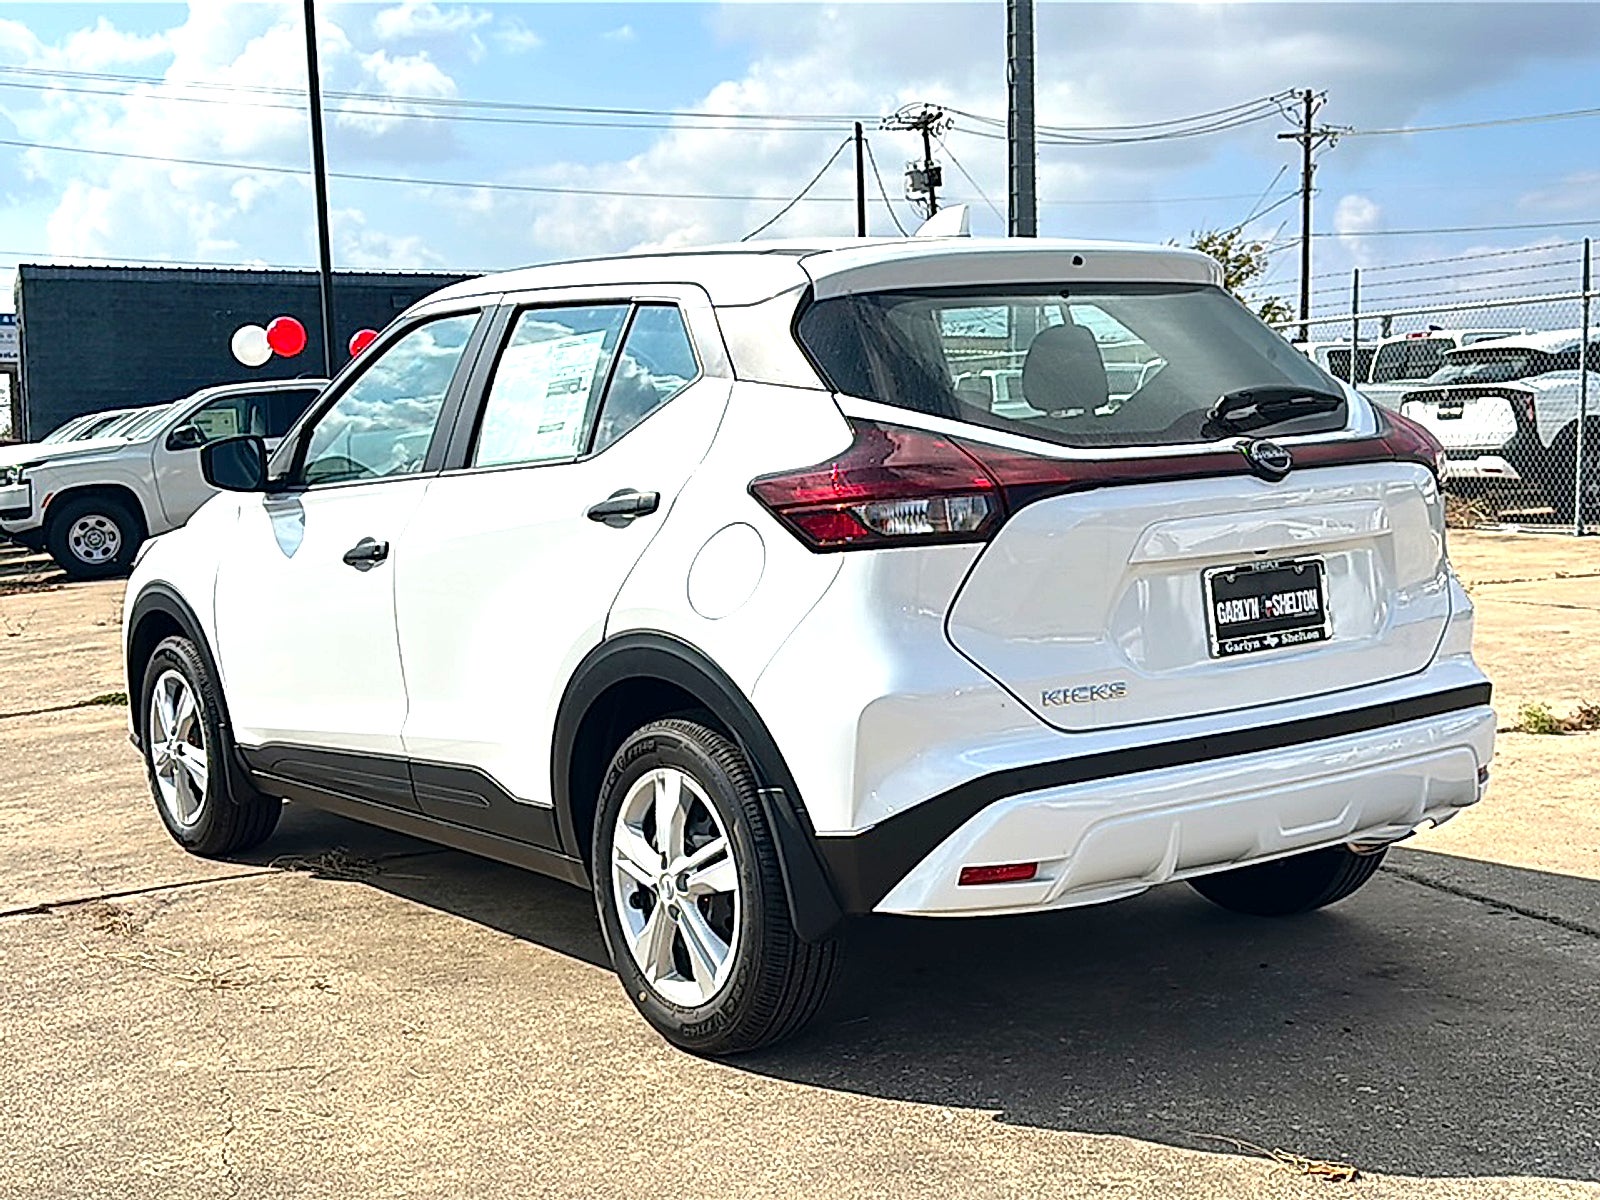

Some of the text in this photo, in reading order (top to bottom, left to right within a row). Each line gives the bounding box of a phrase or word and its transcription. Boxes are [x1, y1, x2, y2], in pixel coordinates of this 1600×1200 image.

[1217, 589, 1319, 624] GARLYN SHELTON
[1225, 631, 1319, 652] Garlyn Shelton
[1041, 681, 1128, 707] KICKS
